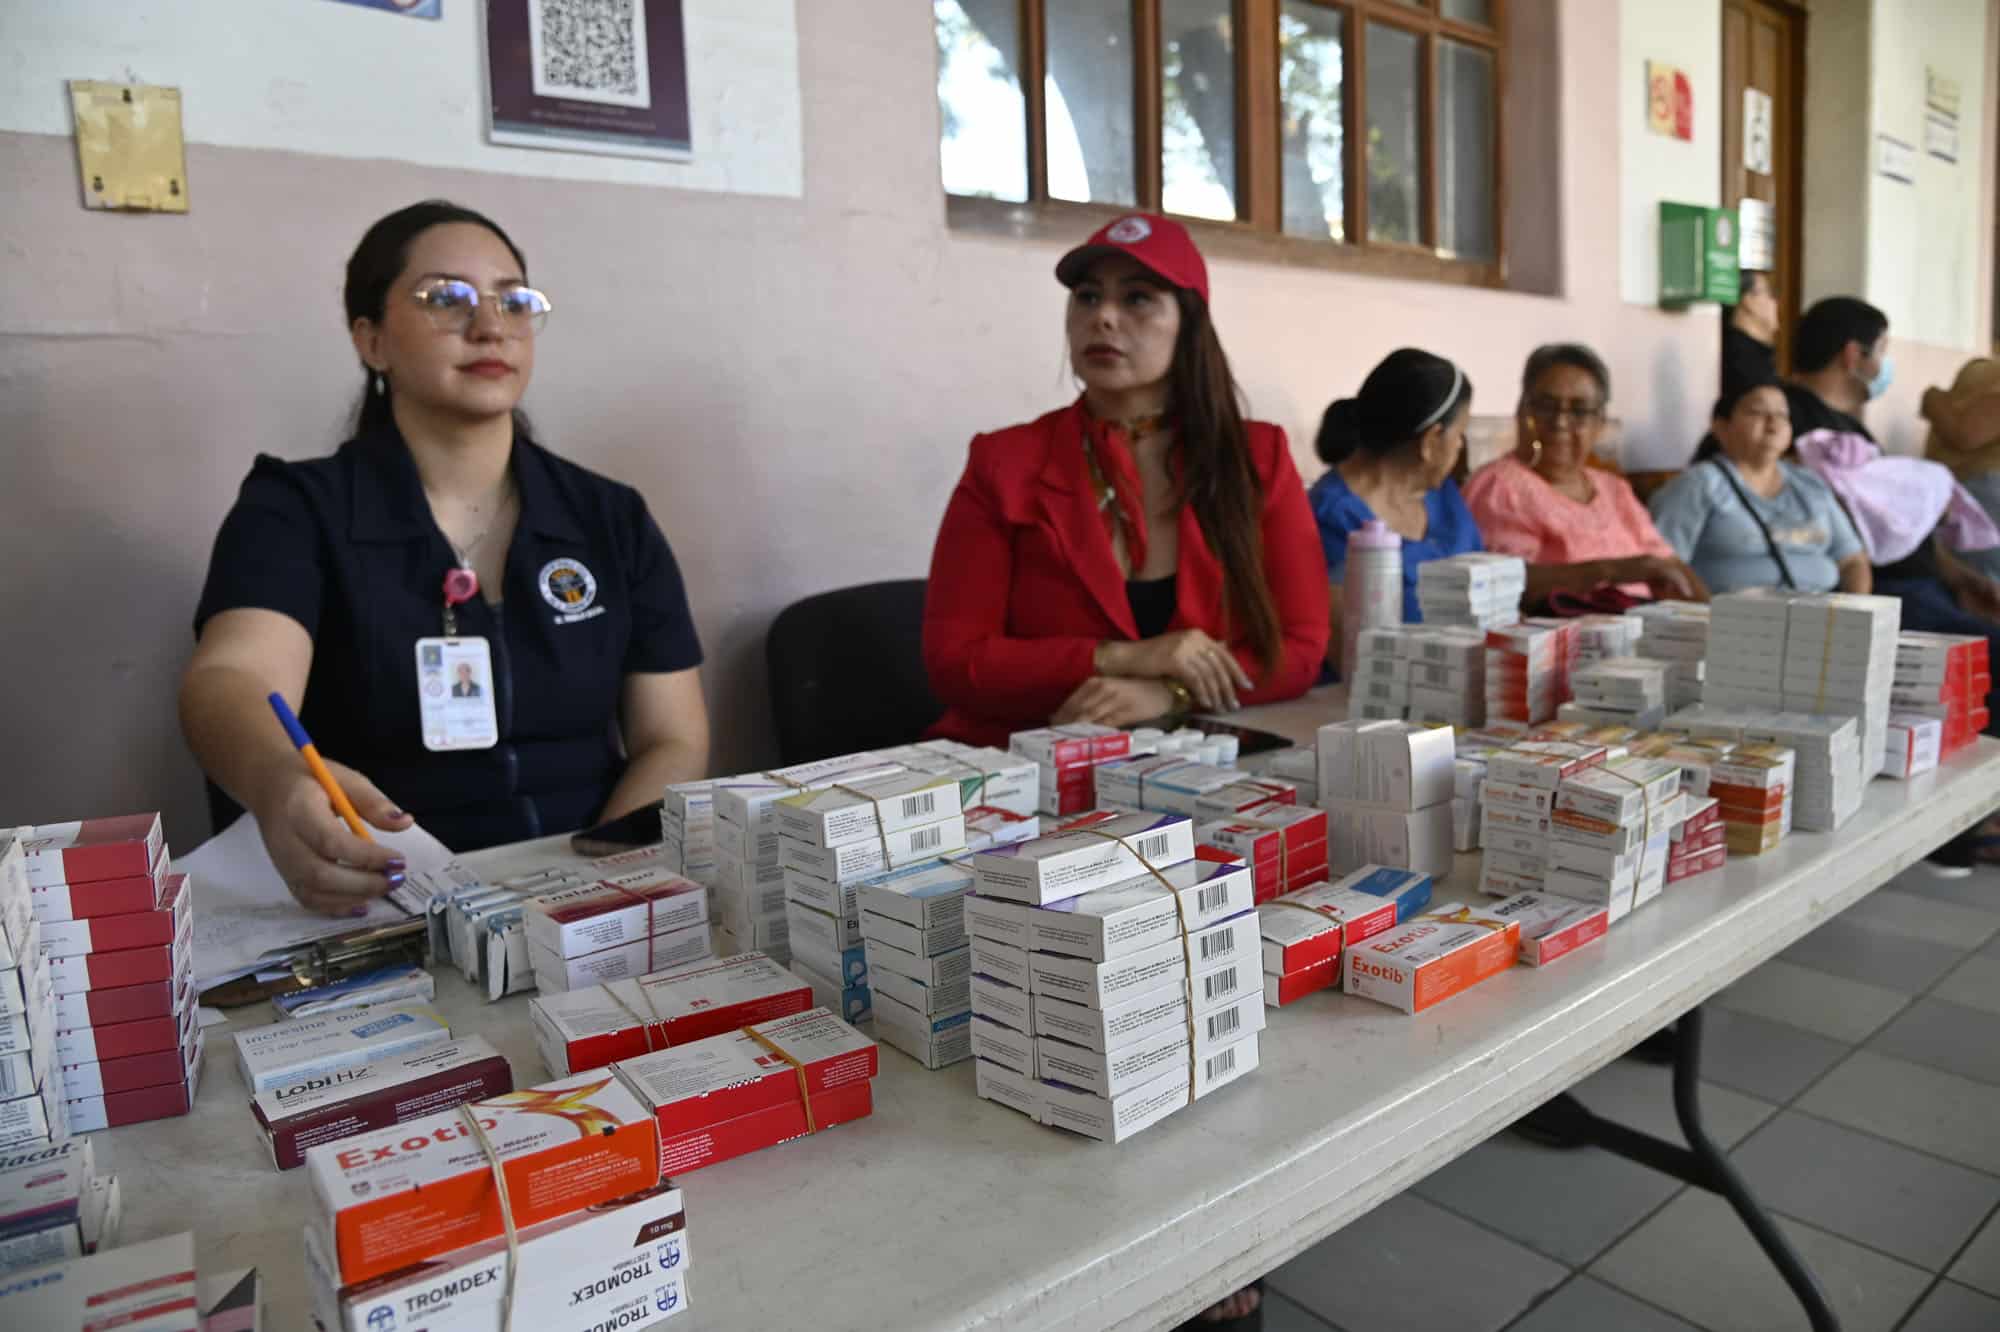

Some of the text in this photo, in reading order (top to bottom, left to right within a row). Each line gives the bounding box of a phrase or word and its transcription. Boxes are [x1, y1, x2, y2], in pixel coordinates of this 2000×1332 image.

[1370, 925, 1439, 954] Exotib
[1352, 955, 1404, 985] Exotib
[275, 1076, 332, 1100] Lobi
[404, 1266, 498, 1312] TROMDEX
[572, 1262, 654, 1305] TROMDEX
[583, 1304, 651, 1332] TROMD
